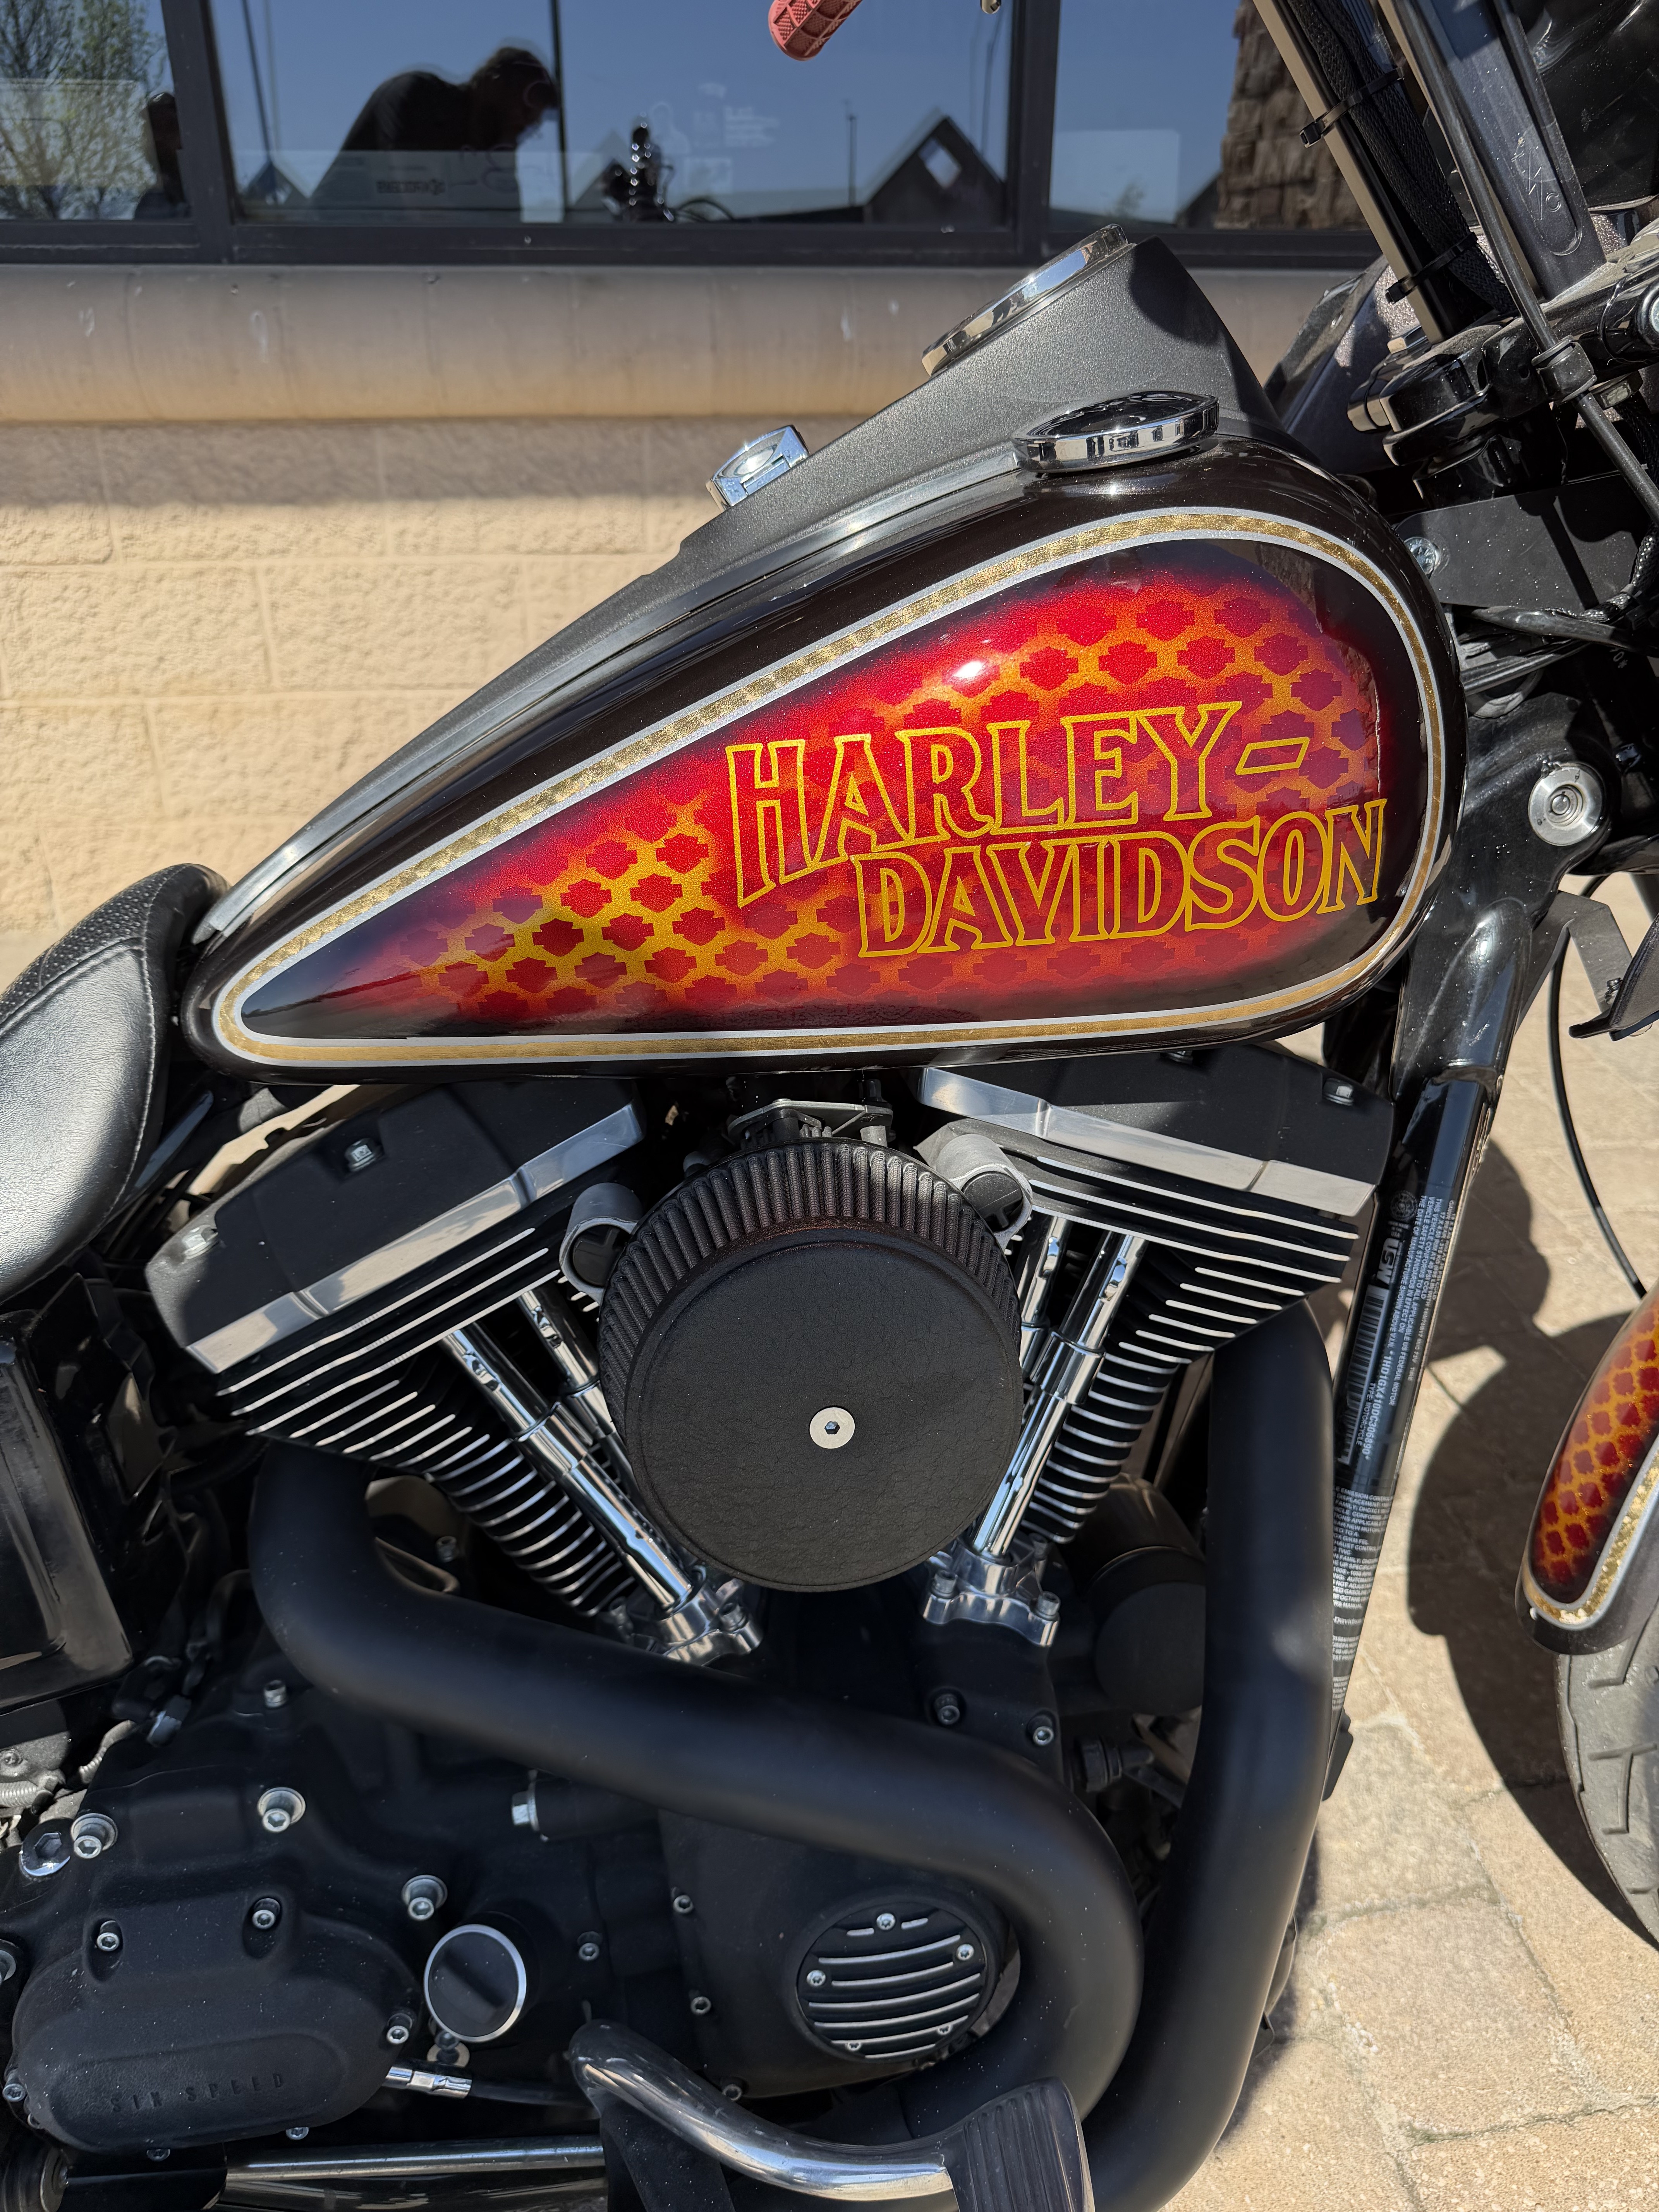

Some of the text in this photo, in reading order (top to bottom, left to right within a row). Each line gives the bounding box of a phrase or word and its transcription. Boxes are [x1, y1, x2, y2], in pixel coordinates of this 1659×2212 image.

[725, 701, 1311, 908] HARLEY-
[850, 799, 1387, 958] DAVIDSON
[1418, 1194, 1428, 1208] THE
[1433, 1197, 1443, 1213] THIS
[1414, 1208, 1425, 1226] DATE
[1426, 1212, 1439, 1241] VEHICLE
[1440, 1219, 1450, 1239] REAR
[1412, 1226, 1420, 1236] OF
[1375, 1237, 1399, 1285] USW
[1398, 1195, 1436, 1334] VEHICLE SAFETY STANDARDS IN EFFECT ON
[1400, 1236, 1418, 1285] MANUFACTURE
[1418, 1240, 1432, 1279] CONFORMS
[1429, 1251, 1437, 1260] AT
[1434, 1254, 1442, 1265] KG
[1413, 1288, 1422, 1301] ALL
[1415, 1278, 1424, 1289] TO
[1420, 1280, 1430, 1300] COLD
[1395, 1285, 1407, 1310] SHOWN
[1425, 1290, 1434, 1307] WITH
[1389, 1309, 1401, 1333] ABOVE
[1403, 1301, 1419, 1341] APPLICABLE
[1394, 1351, 1407, 1382] FEDERAL
[1388, 1381, 1400, 1406] MOTOR
[1355, 1382, 1376, 1446] TYPE: MOTORCYCLE
[1341, 1487, 1368, 1499] EMISSION
[185, 2073, 283, 2102] SPEED
